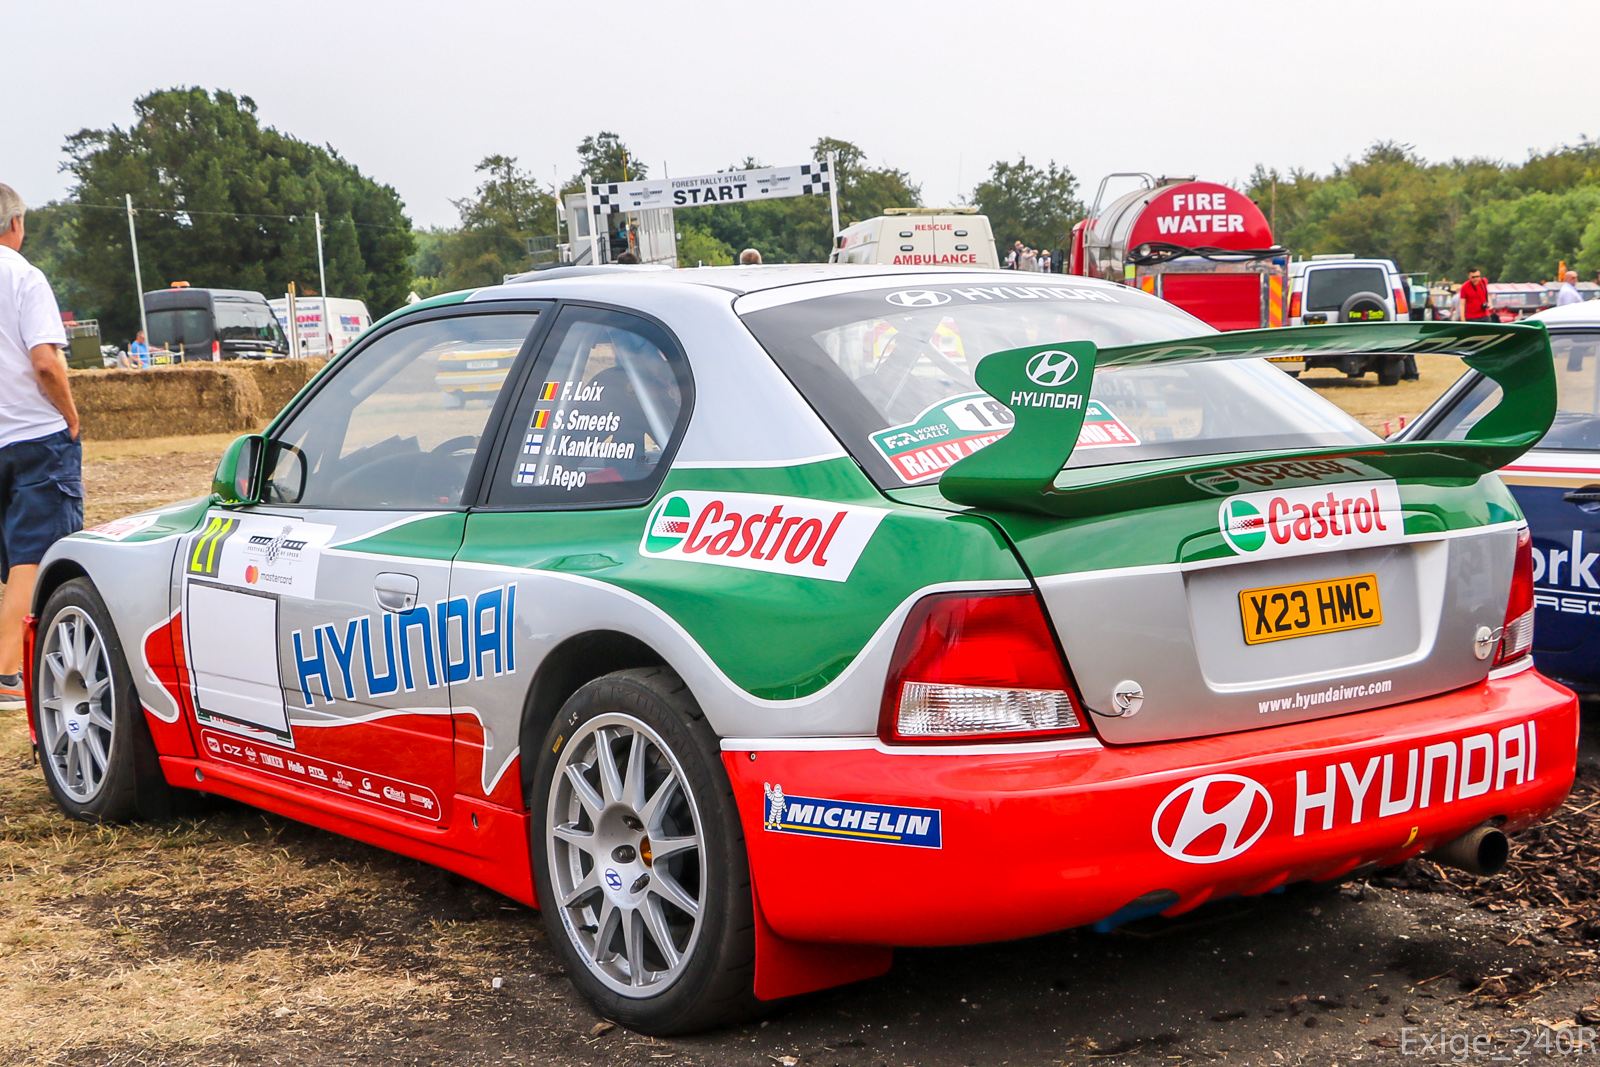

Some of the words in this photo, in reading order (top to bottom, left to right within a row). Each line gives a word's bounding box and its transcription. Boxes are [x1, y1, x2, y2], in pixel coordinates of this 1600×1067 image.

[672, 178, 699, 188] FOREST
[700, 176, 722, 186] RALLY
[724, 174, 747, 184] STAGE
[673, 184, 748, 206] START
[1173, 193, 1226, 211] FIRE
[915, 223, 953, 231] RESCUE
[1157, 214, 1244, 234] WATER
[893, 254, 977, 265] AMBULANCE
[950, 286, 1120, 303] HYUNDAI
[560, 381, 573, 401] F.
[573, 381, 605, 402] Loix
[1009, 390, 1083, 410] HYUNDAI
[552, 409, 566, 430] S.
[567, 410, 621, 432] Smeets
[965, 401, 1015, 427] 18
[914, 423, 947, 436] WORLD
[918, 427, 950, 441] RALLY
[545, 435, 557, 456] J.
[557, 435, 635, 459] Kankkunen
[898, 442, 965, 476] RALLY
[538, 464, 550, 485] J.
[551, 465, 587, 491] Repo
[1268, 488, 1388, 546] Castrol
[191, 517, 234, 573] 21
[682, 500, 849, 568] Castrol
[260, 572, 293, 585] mastercard
[1250, 589, 1311, 635] X23
[1316, 581, 1374, 627] HMC
[292, 582, 518, 708] HYUNDAI
[1258, 678, 1393, 714] www.hyundaiwrc.com
[222, 743, 243, 757] OZ
[287, 760, 306, 775] Hella
[1293, 720, 1537, 837] HYUNDAI
[786, 802, 932, 837] MICHELIN
